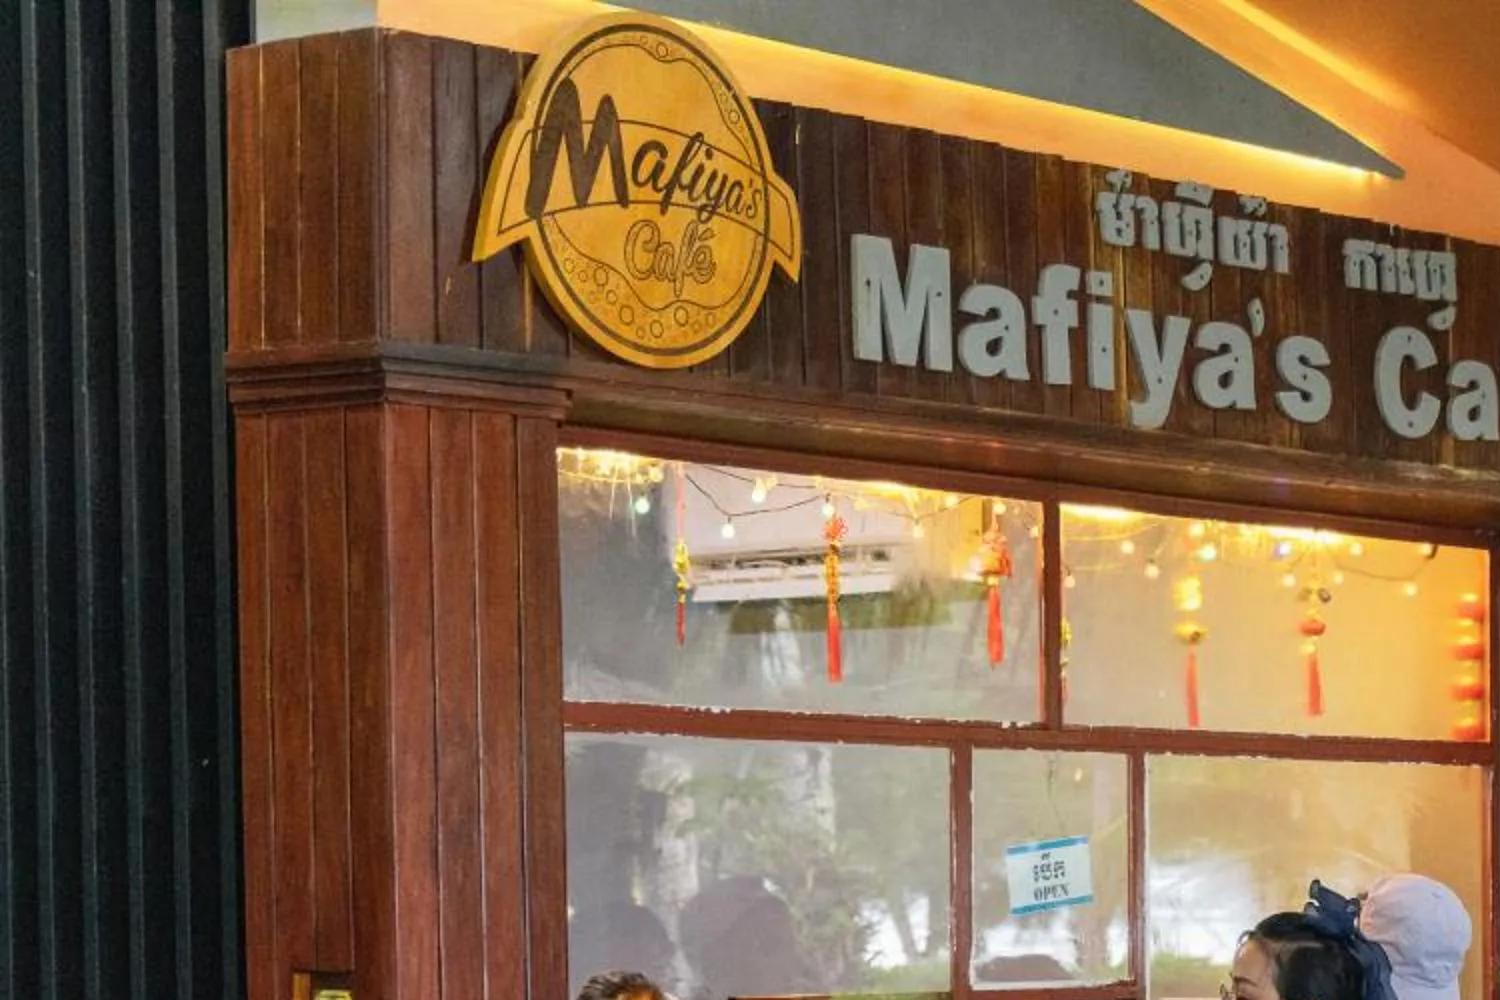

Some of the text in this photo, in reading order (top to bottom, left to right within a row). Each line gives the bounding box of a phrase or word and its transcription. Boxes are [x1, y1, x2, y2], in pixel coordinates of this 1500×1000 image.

[525, 76, 763, 223] Mafiya's
[850, 233, 1333, 430] Mafiya's
[1033, 883, 1070, 901] OPEN
